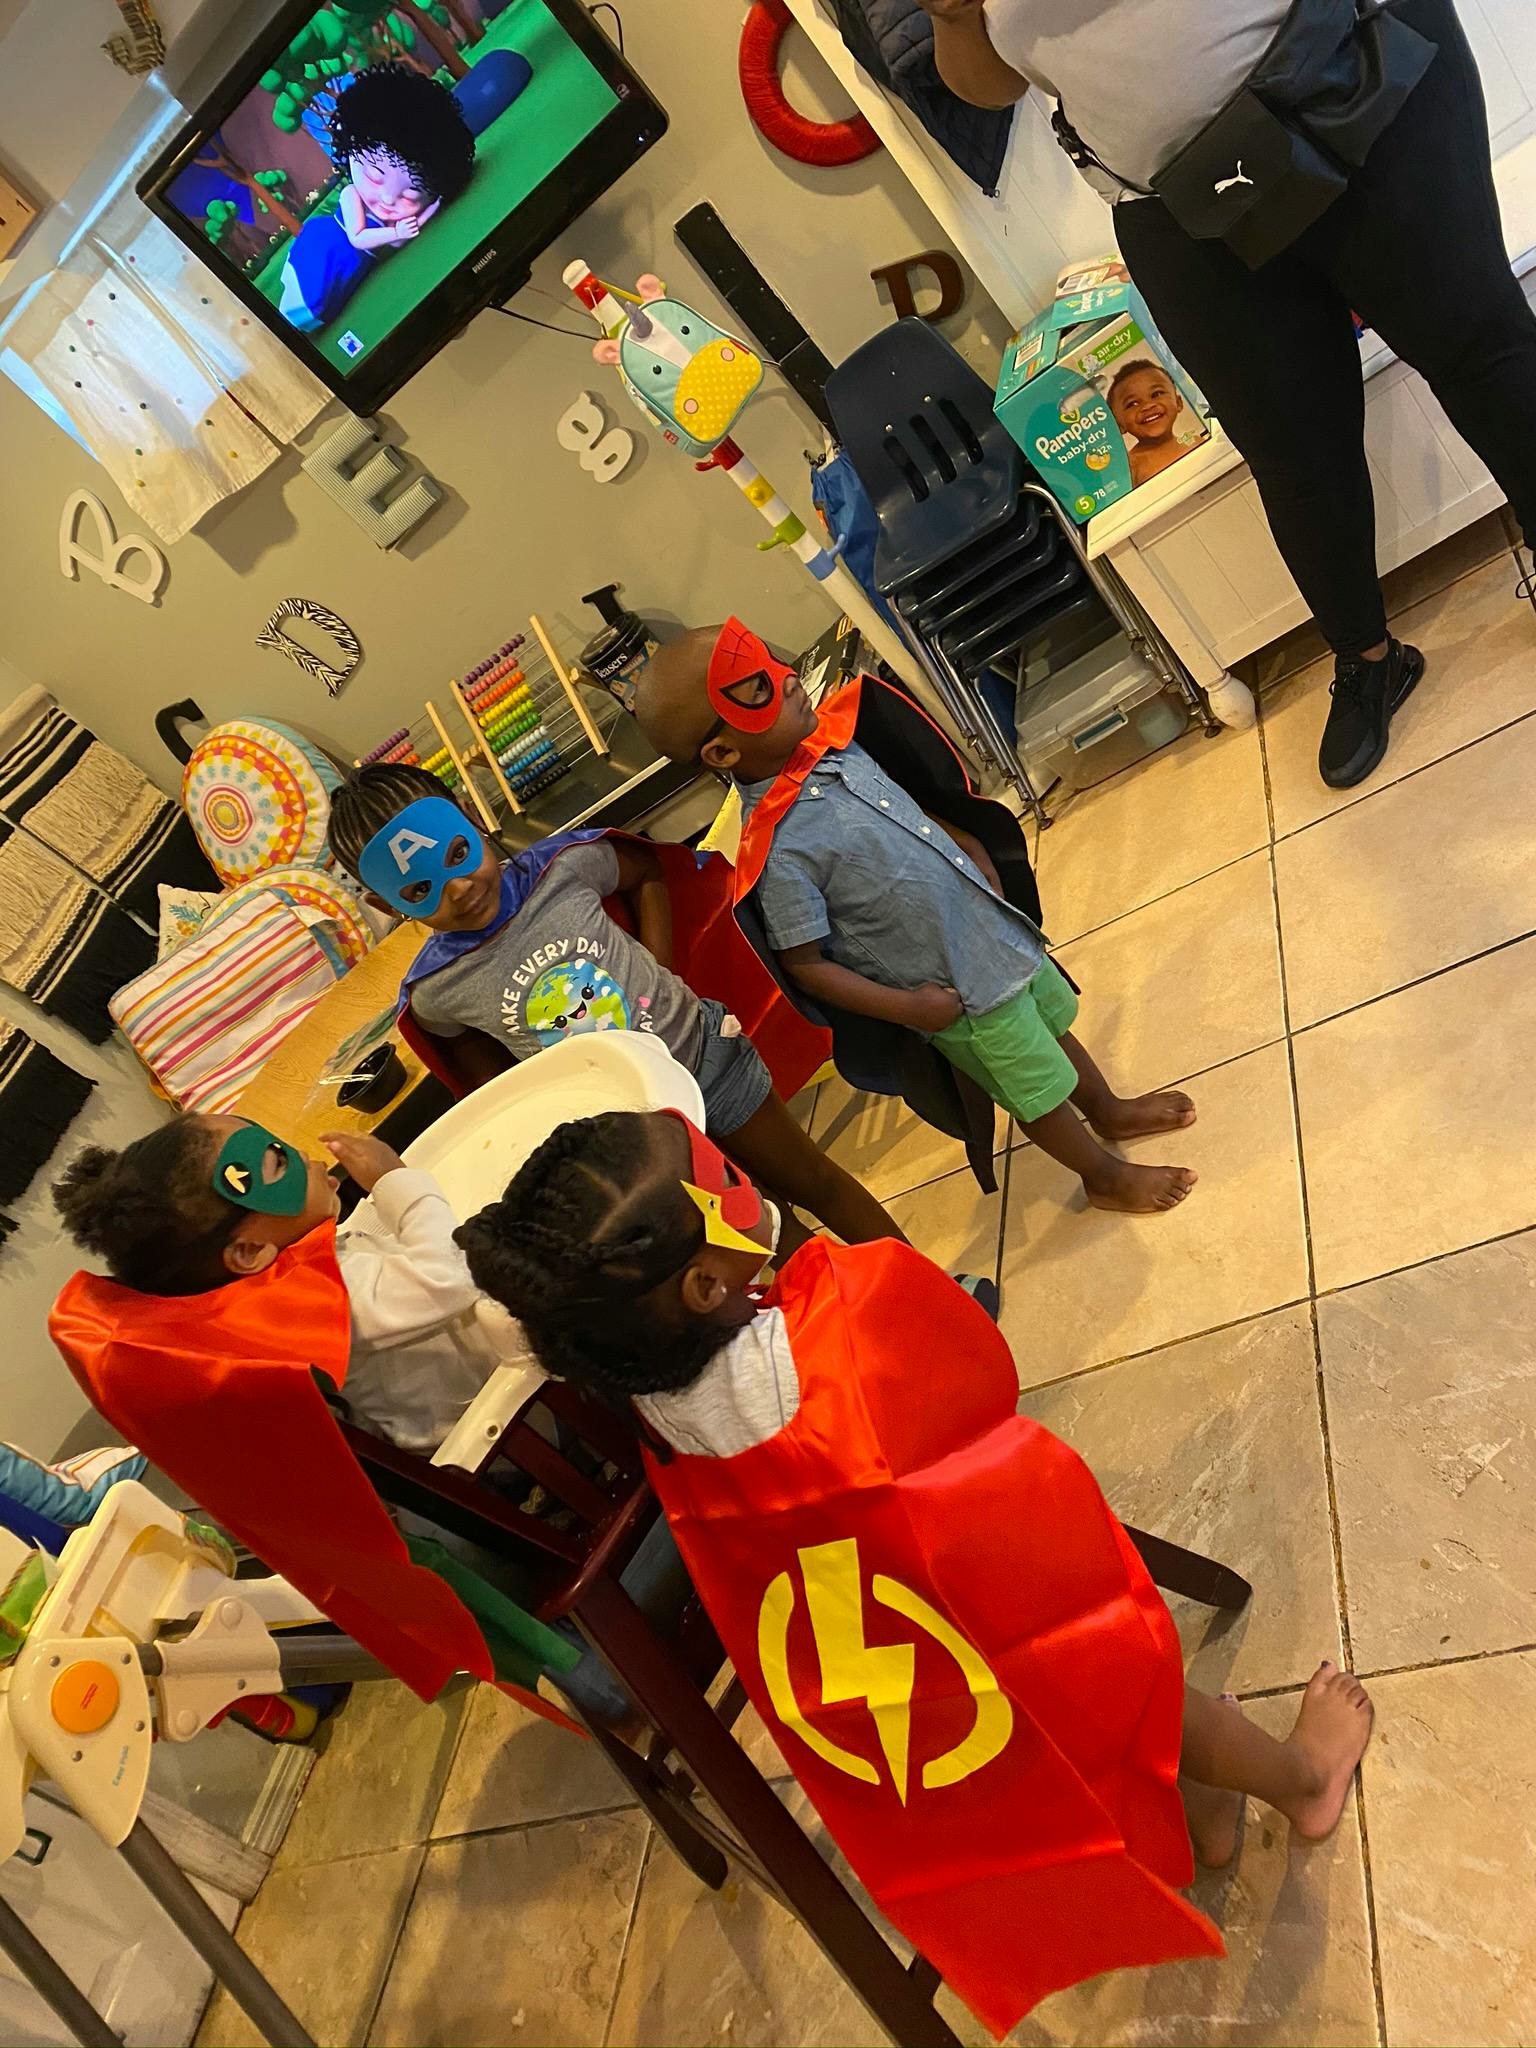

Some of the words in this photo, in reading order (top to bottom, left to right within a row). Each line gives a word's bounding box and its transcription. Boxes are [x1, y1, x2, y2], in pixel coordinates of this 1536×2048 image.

[472, 248, 497, 274] PHILIPS
[1036, 406, 1107, 459] Pampers
[1058, 427, 1106, 464] baby-dry
[301, 413, 442, 552] E
[1079, 497, 1090, 510] 5
[1093, 488, 1107, 500] 78
[59, 488, 167, 605] B
[255, 597, 362, 697] D
[388, 828, 439, 875] A
[512, 938, 569, 986] EVERY
[576, 936, 606, 959] DAY
